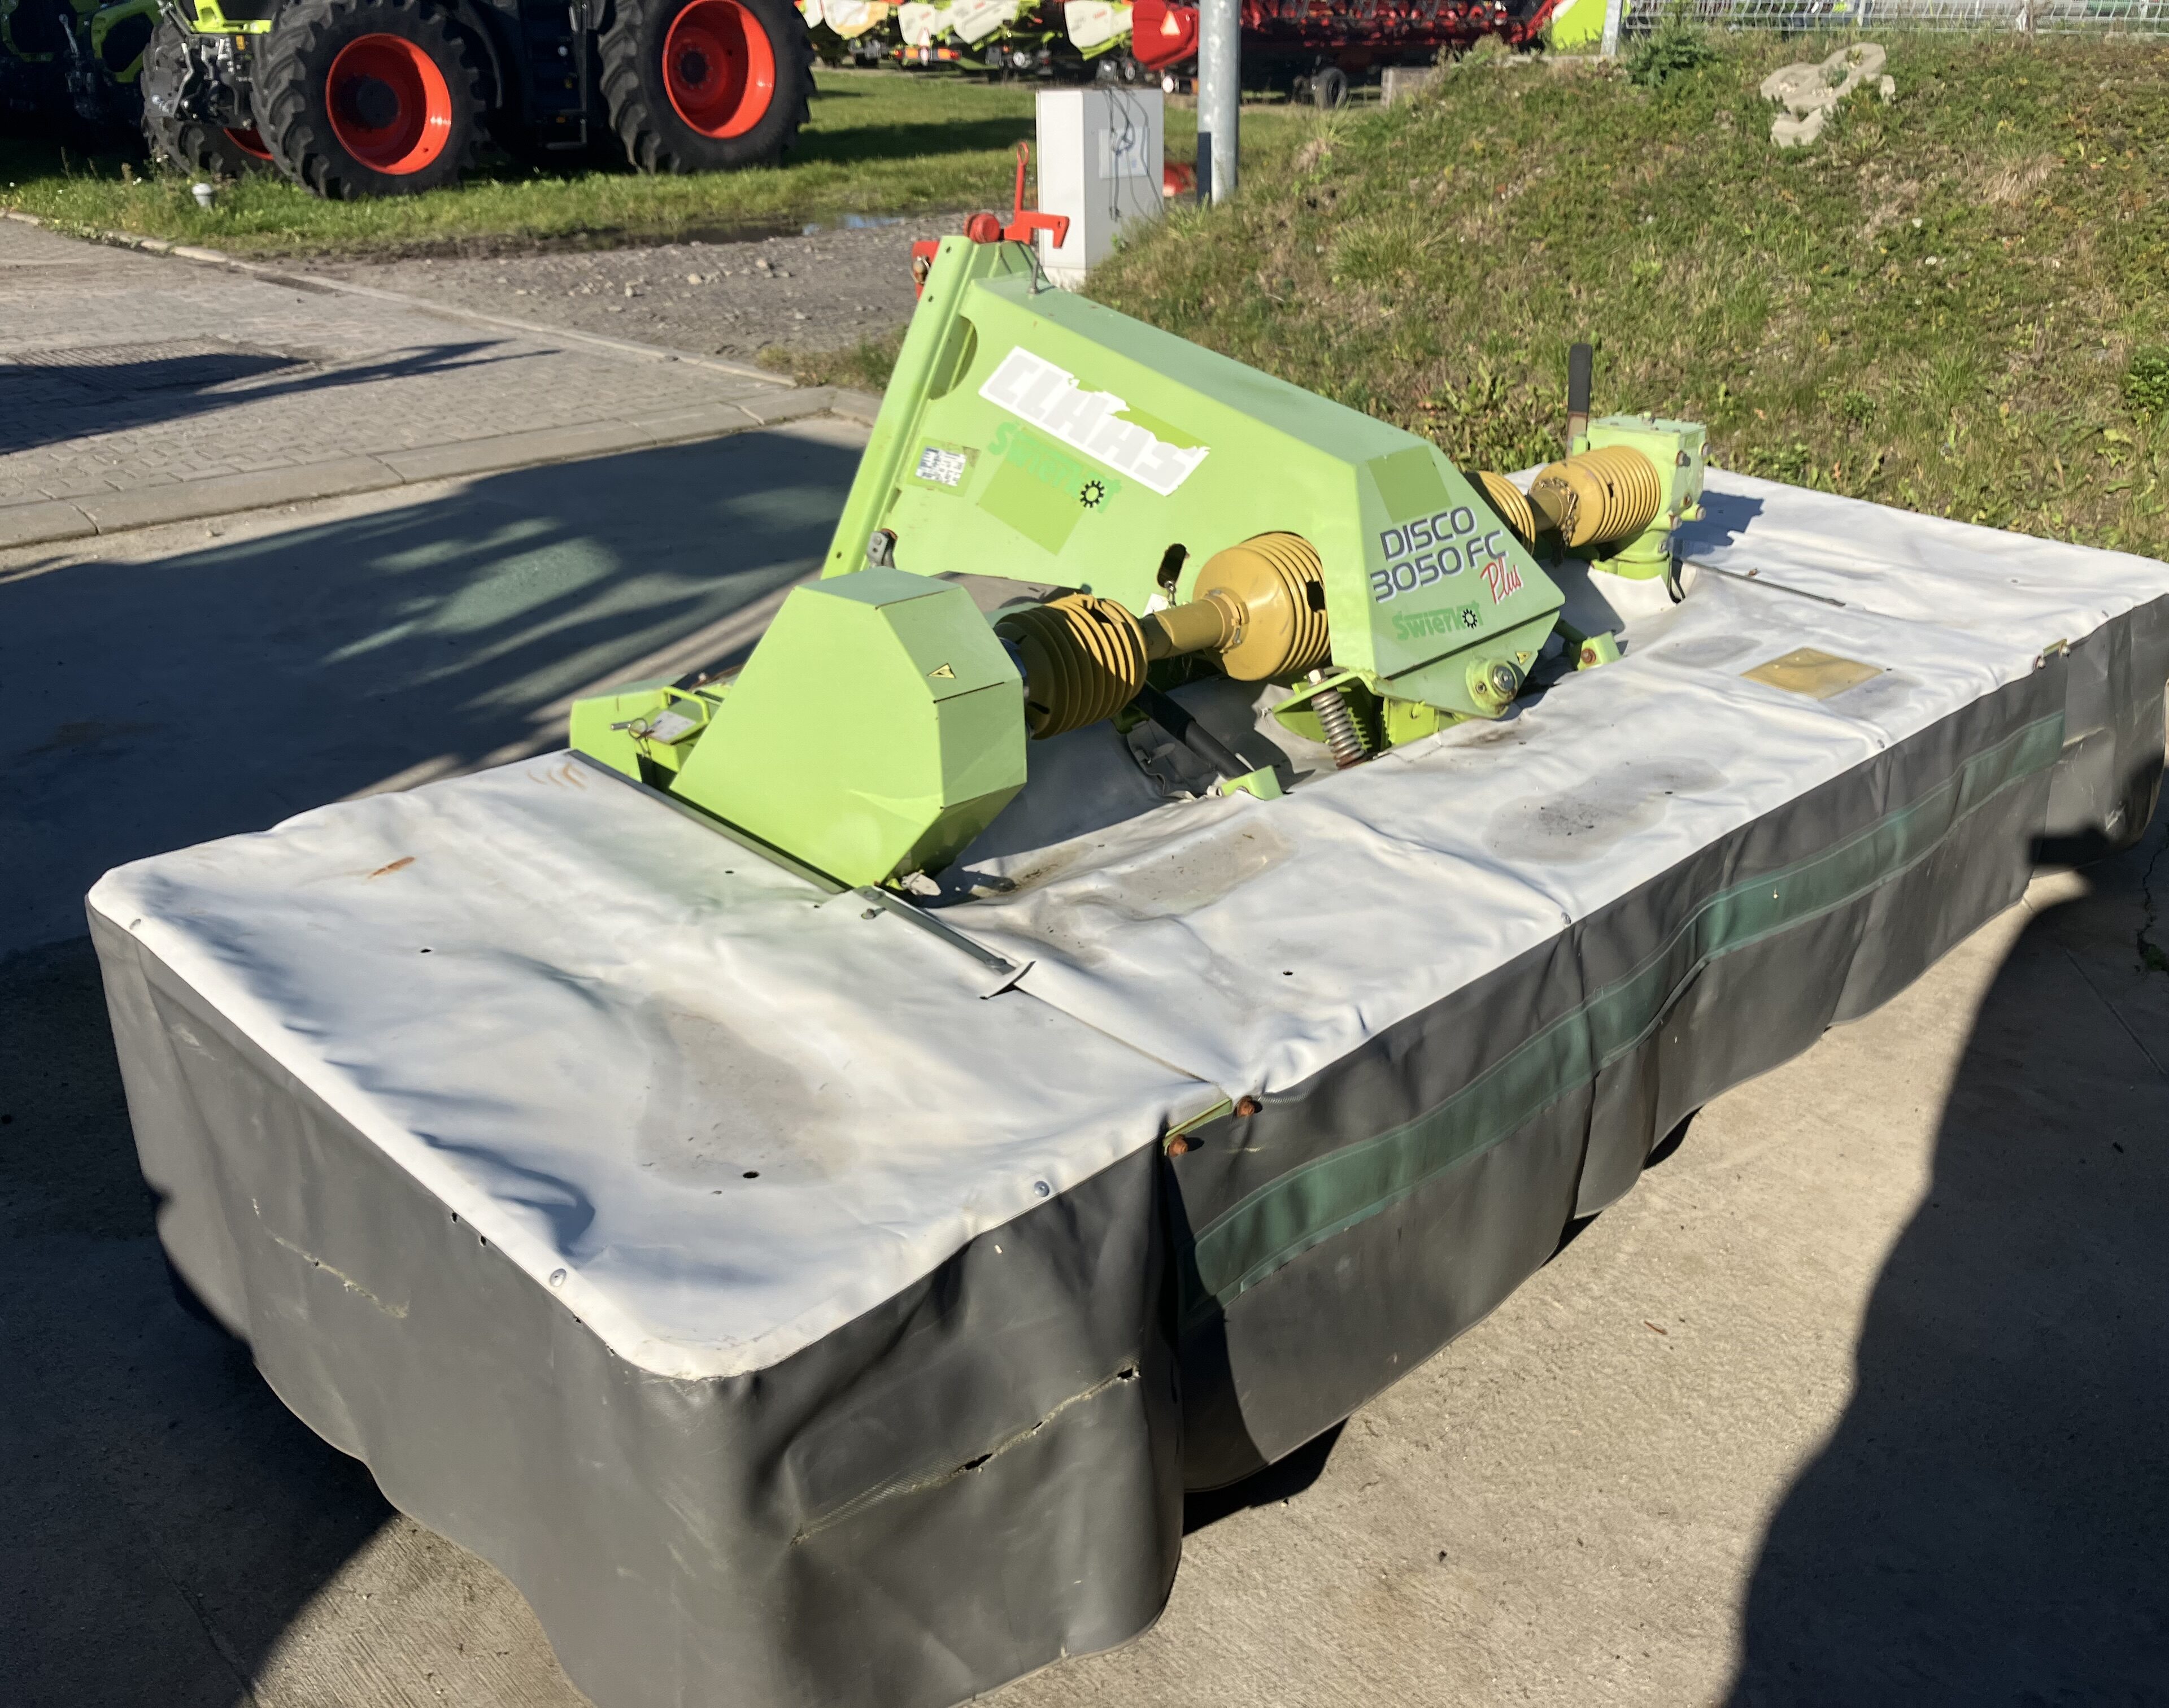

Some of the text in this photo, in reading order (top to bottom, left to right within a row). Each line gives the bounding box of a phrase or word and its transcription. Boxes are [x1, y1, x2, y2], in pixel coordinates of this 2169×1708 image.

[1379, 506, 1478, 561] DISCO
[1370, 529, 1509, 603] 3050 FC
[1480, 556, 1523, 605] Plus
